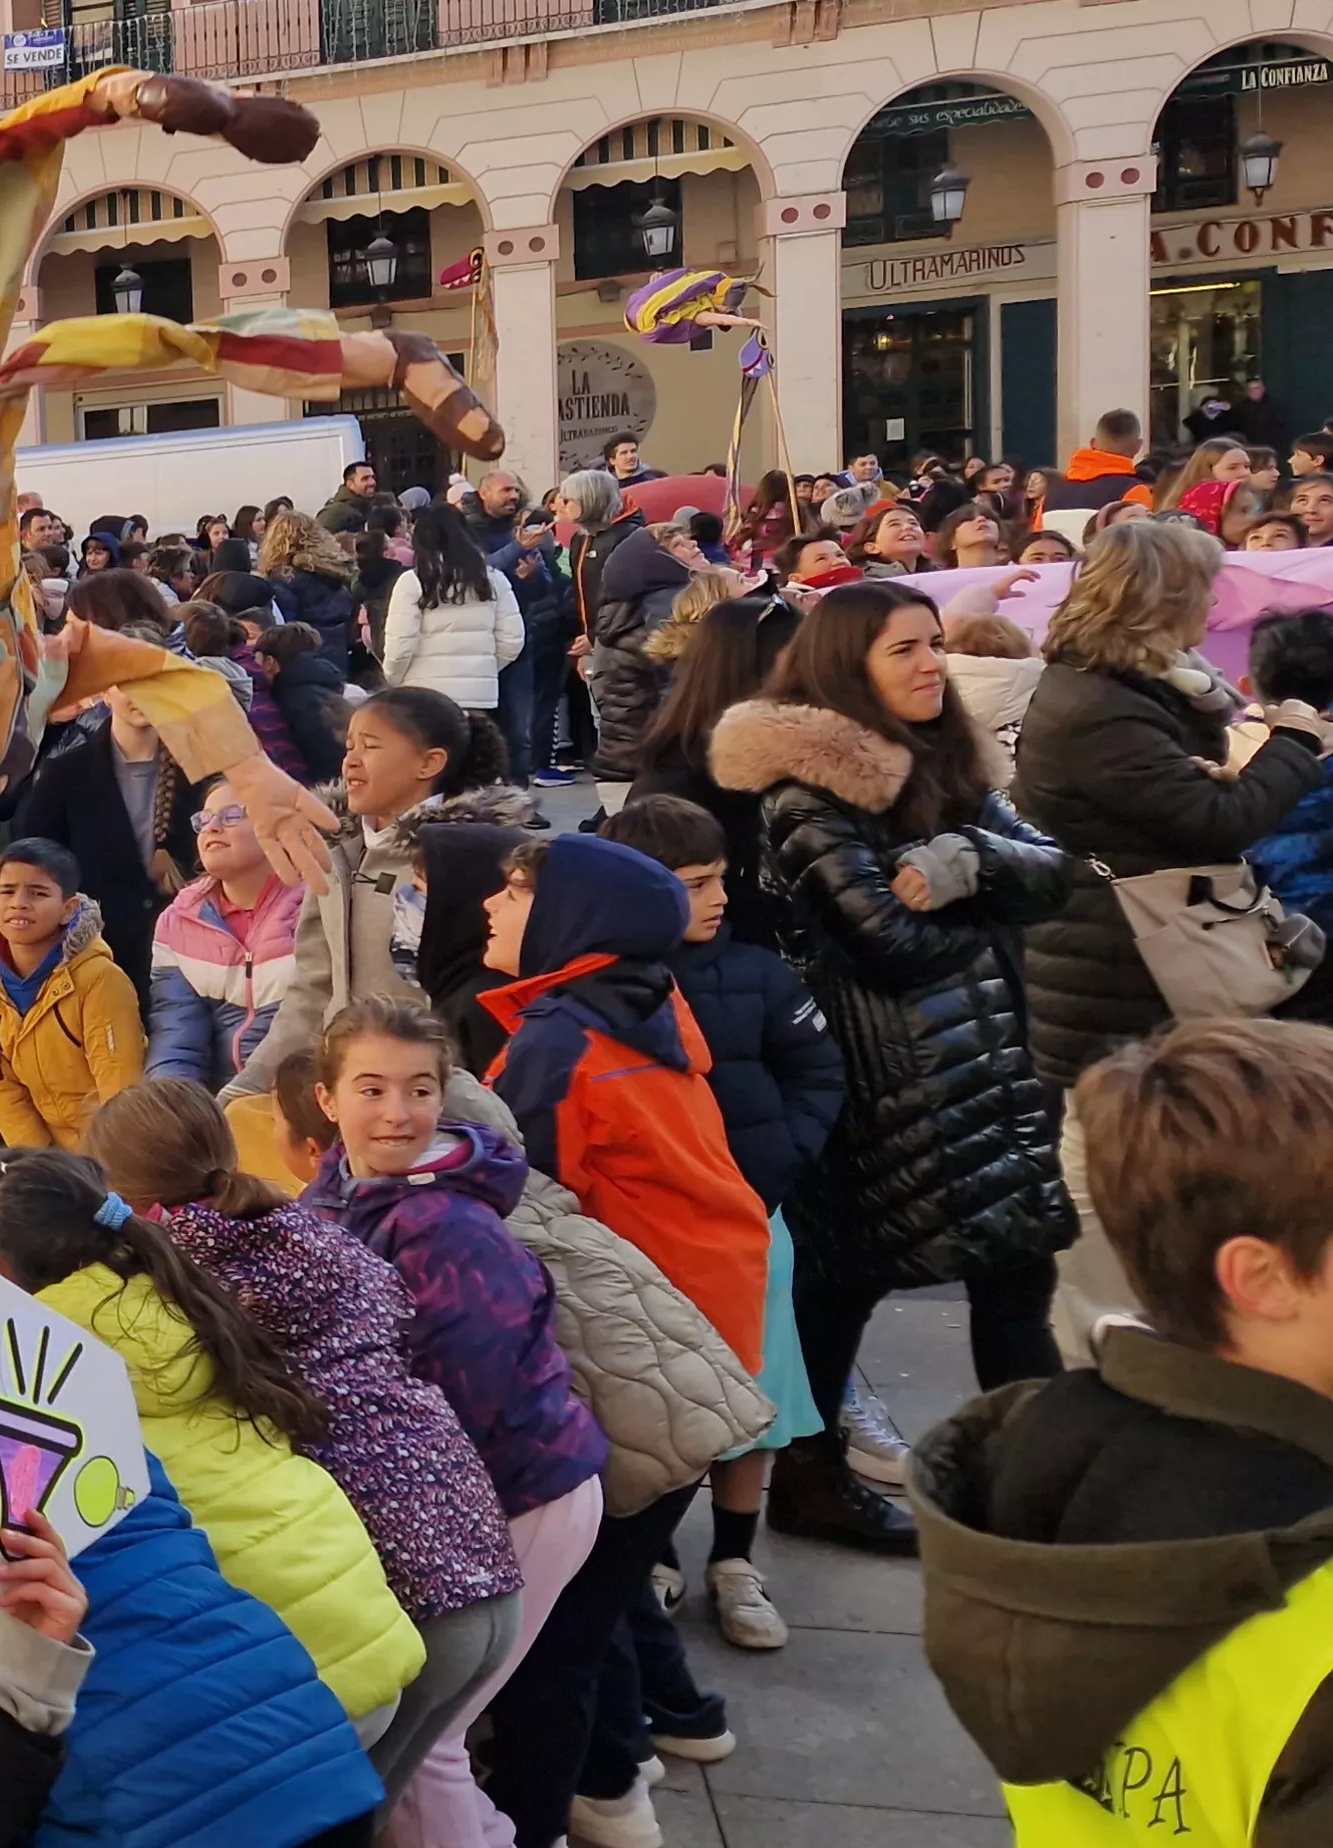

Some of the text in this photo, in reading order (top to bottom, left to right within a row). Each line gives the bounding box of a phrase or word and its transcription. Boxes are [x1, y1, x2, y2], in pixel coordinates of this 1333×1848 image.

[6, 47, 62, 65] SE VENDE
[1241, 63, 1329, 90] LA CONFIANZA
[908, 112, 929, 124] sus
[869, 245, 1026, 290] ULTRAMARINOS
[572, 369, 591, 396] LA
